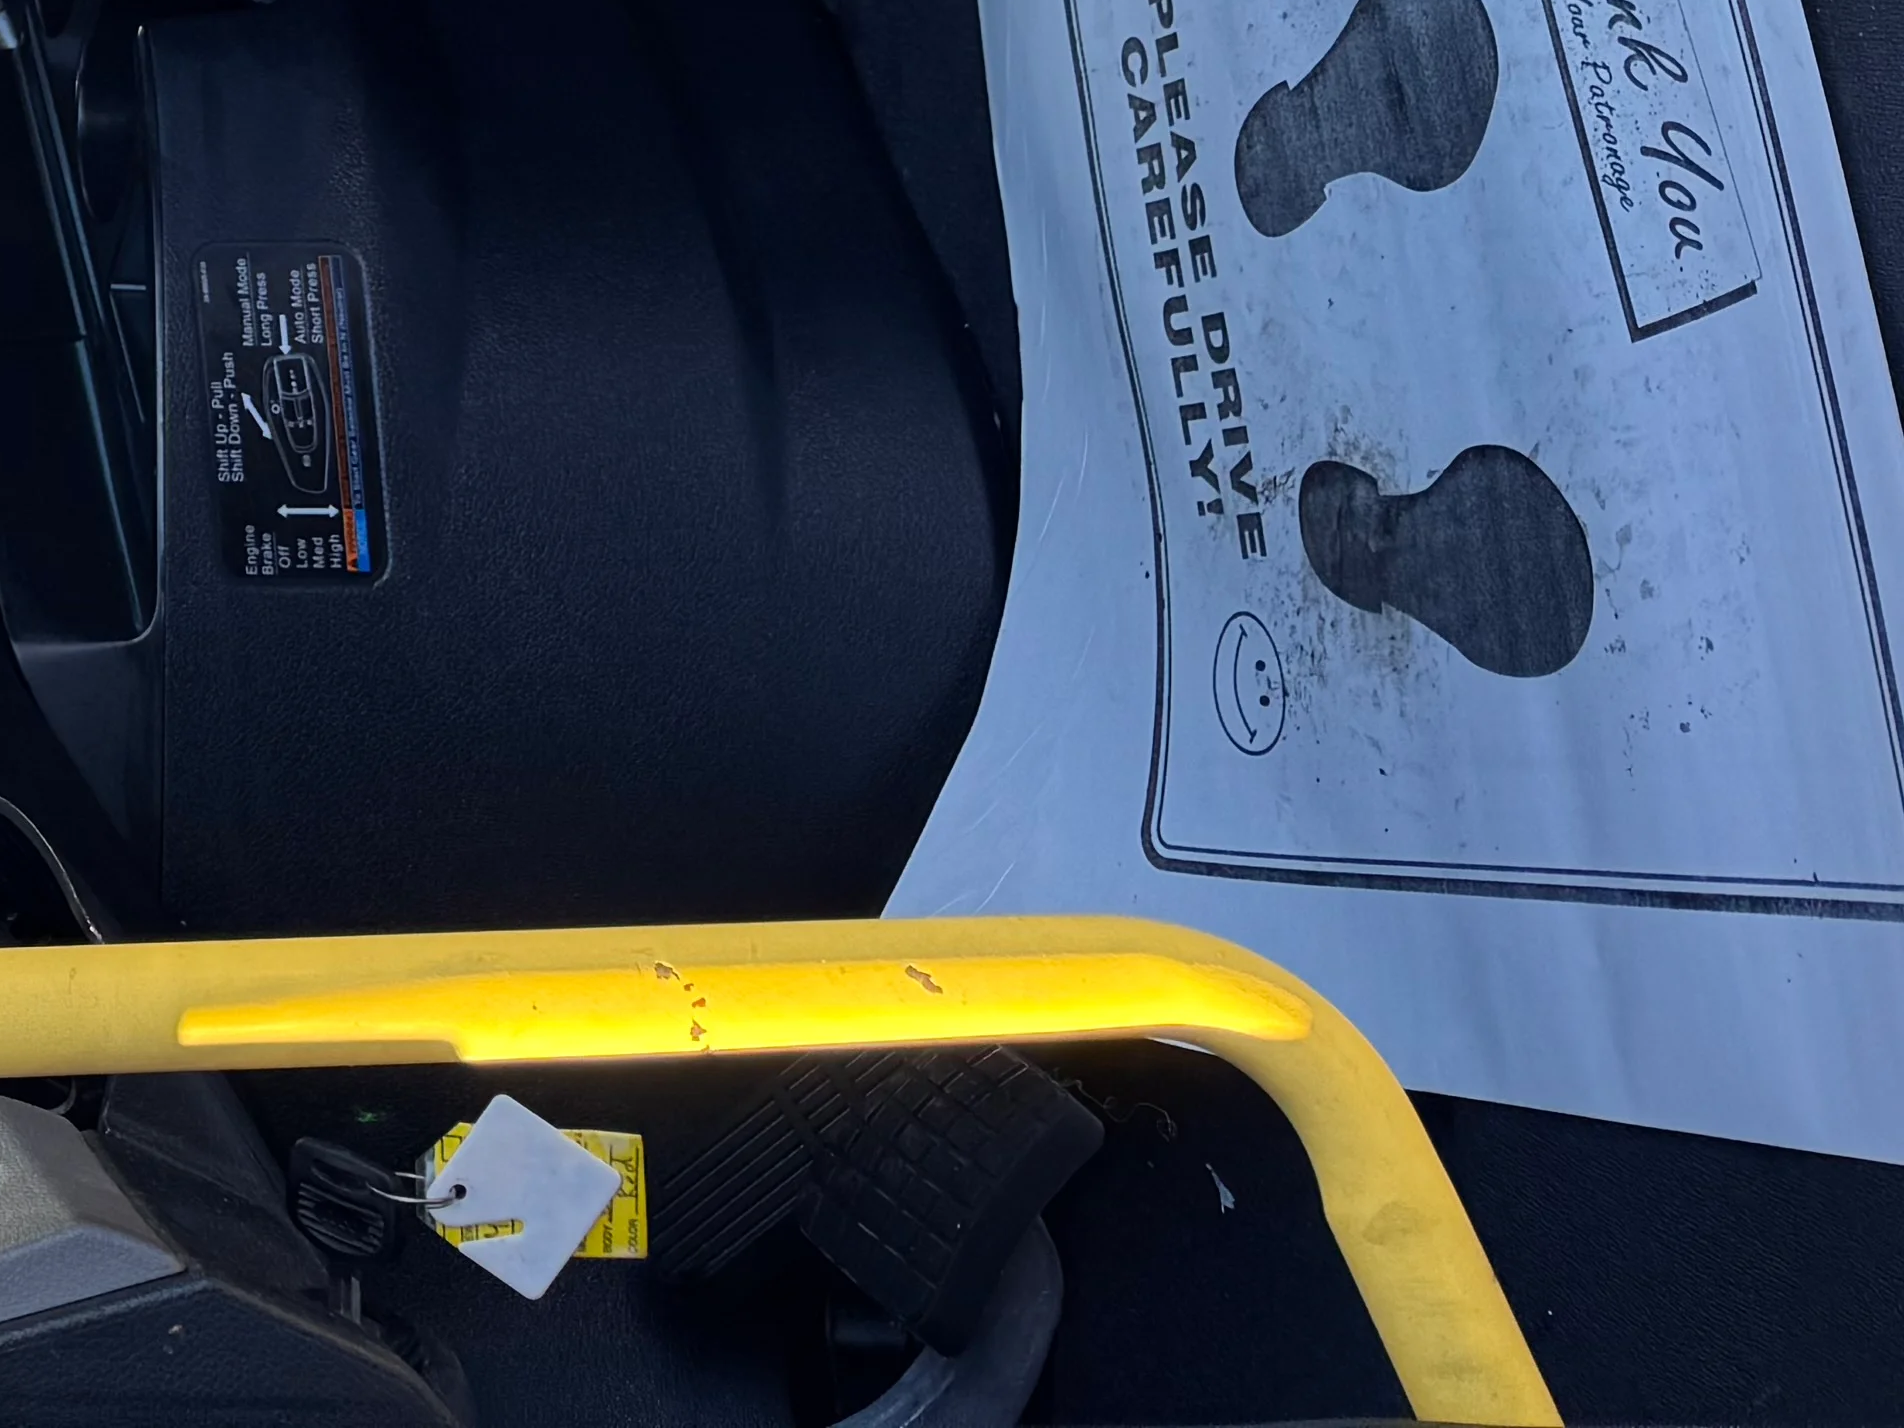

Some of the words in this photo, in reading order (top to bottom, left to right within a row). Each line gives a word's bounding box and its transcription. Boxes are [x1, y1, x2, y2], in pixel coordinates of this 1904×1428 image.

[1581, 61, 1632, 213] Patronage
[1640, 120, 1724, 259] You
[235, 258, 249, 294] Mode
[256, 272, 269, 310] Press
[289, 269, 303, 307] Mode
[306, 263, 319, 302] Press
[1120, 36, 1225, 517] CAREFULLY!
[239, 298, 254, 346] Manual
[257, 314, 272, 346] Long
[294, 312, 306, 344] Auto
[309, 307, 323, 343] Short
[222, 352, 236, 388] Push
[343, 371, 351, 395] Must
[210, 381, 224, 409] Pull
[214, 424, 229, 444] Up
[228, 404, 241, 444] Down
[1201, 312, 1268, 559] DRIVE
[216, 449, 230, 482] Shift
[230, 449, 244, 482] Shift
[350, 440, 358, 464] Gear
[353, 467, 361, 490] Start
[244, 525, 259, 575] Engine
[261, 532, 274, 575] Brake
[278, 546, 291, 568] Off
[296, 538, 308, 568] Low
[312, 537, 325, 568] Med
[329, 534, 343, 568] High
[627, 1218, 638, 1254] COLOR
